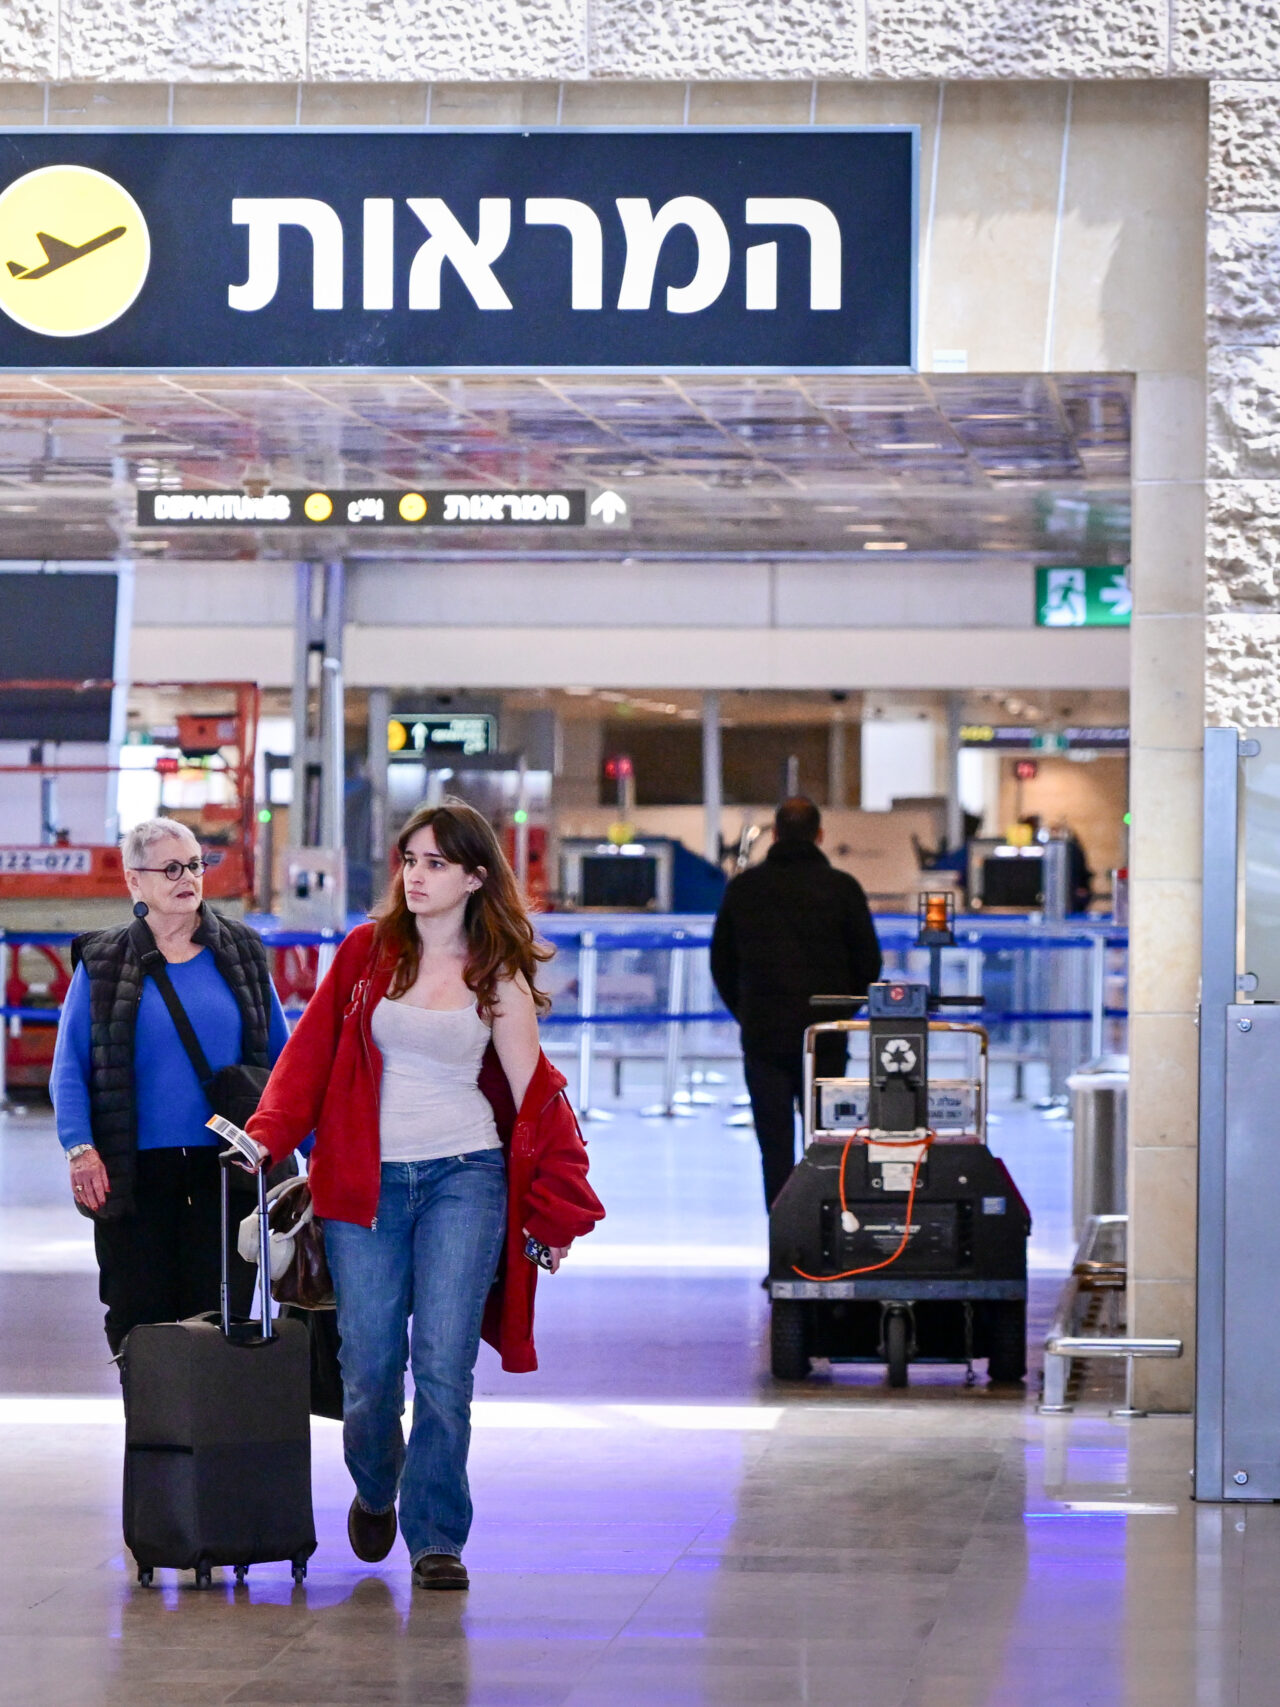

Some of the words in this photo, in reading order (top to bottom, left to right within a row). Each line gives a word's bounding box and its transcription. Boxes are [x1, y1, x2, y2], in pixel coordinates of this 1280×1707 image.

[228, 195, 842, 314] המראות
[154, 494, 291, 520] DEPARTURES
[442, 494, 570, 520] המראות
